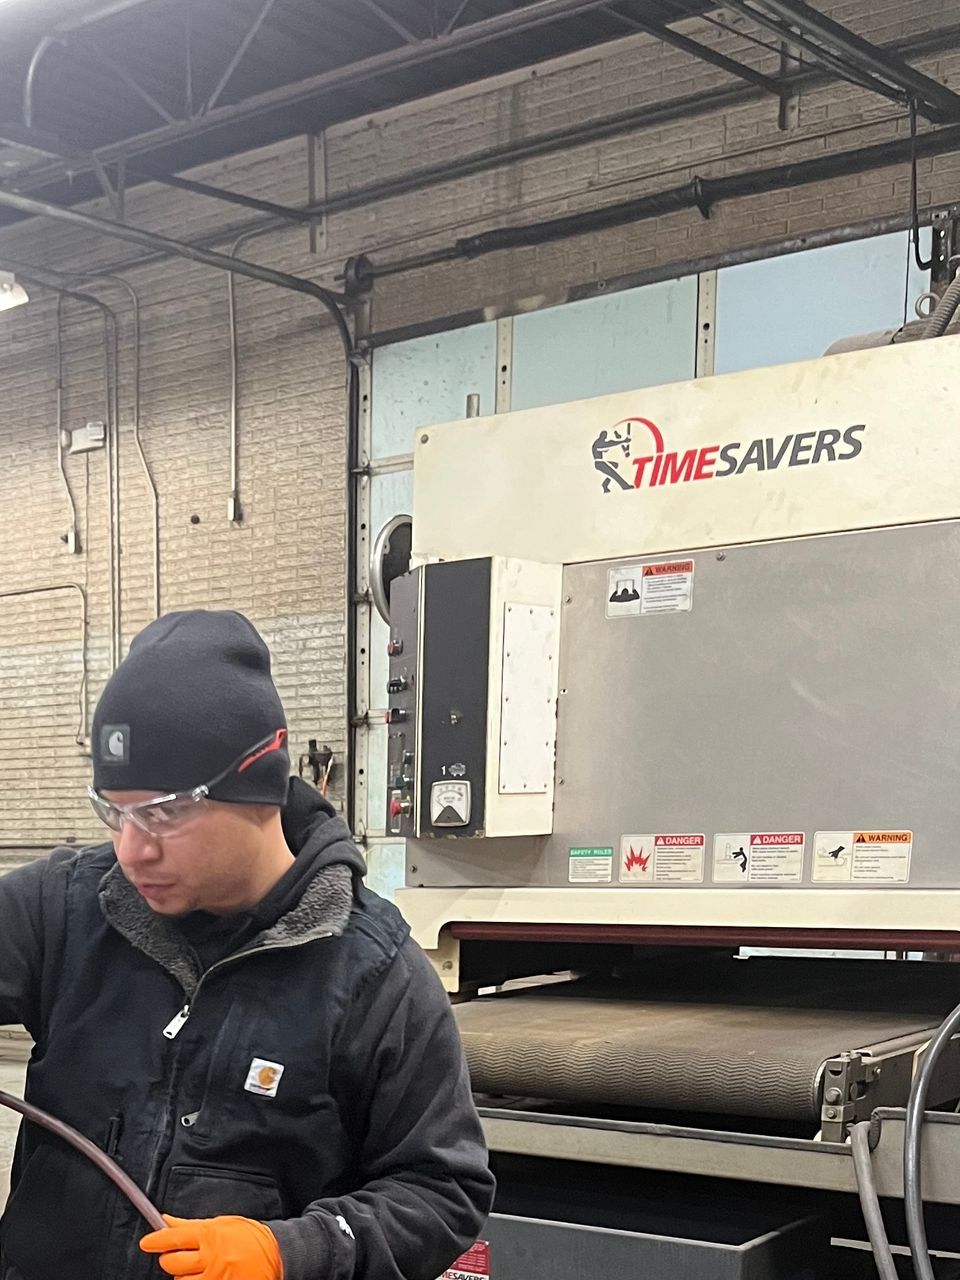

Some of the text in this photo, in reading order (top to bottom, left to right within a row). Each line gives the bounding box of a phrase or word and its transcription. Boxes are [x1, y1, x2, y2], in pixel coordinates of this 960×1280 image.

[631, 423, 866, 488] TIMESAVERS
[655, 562, 690, 574] WARNING
[665, 836, 701, 845] DANGER
[762, 835, 802, 844] DANGER
[867, 833, 908, 842] WARNING
